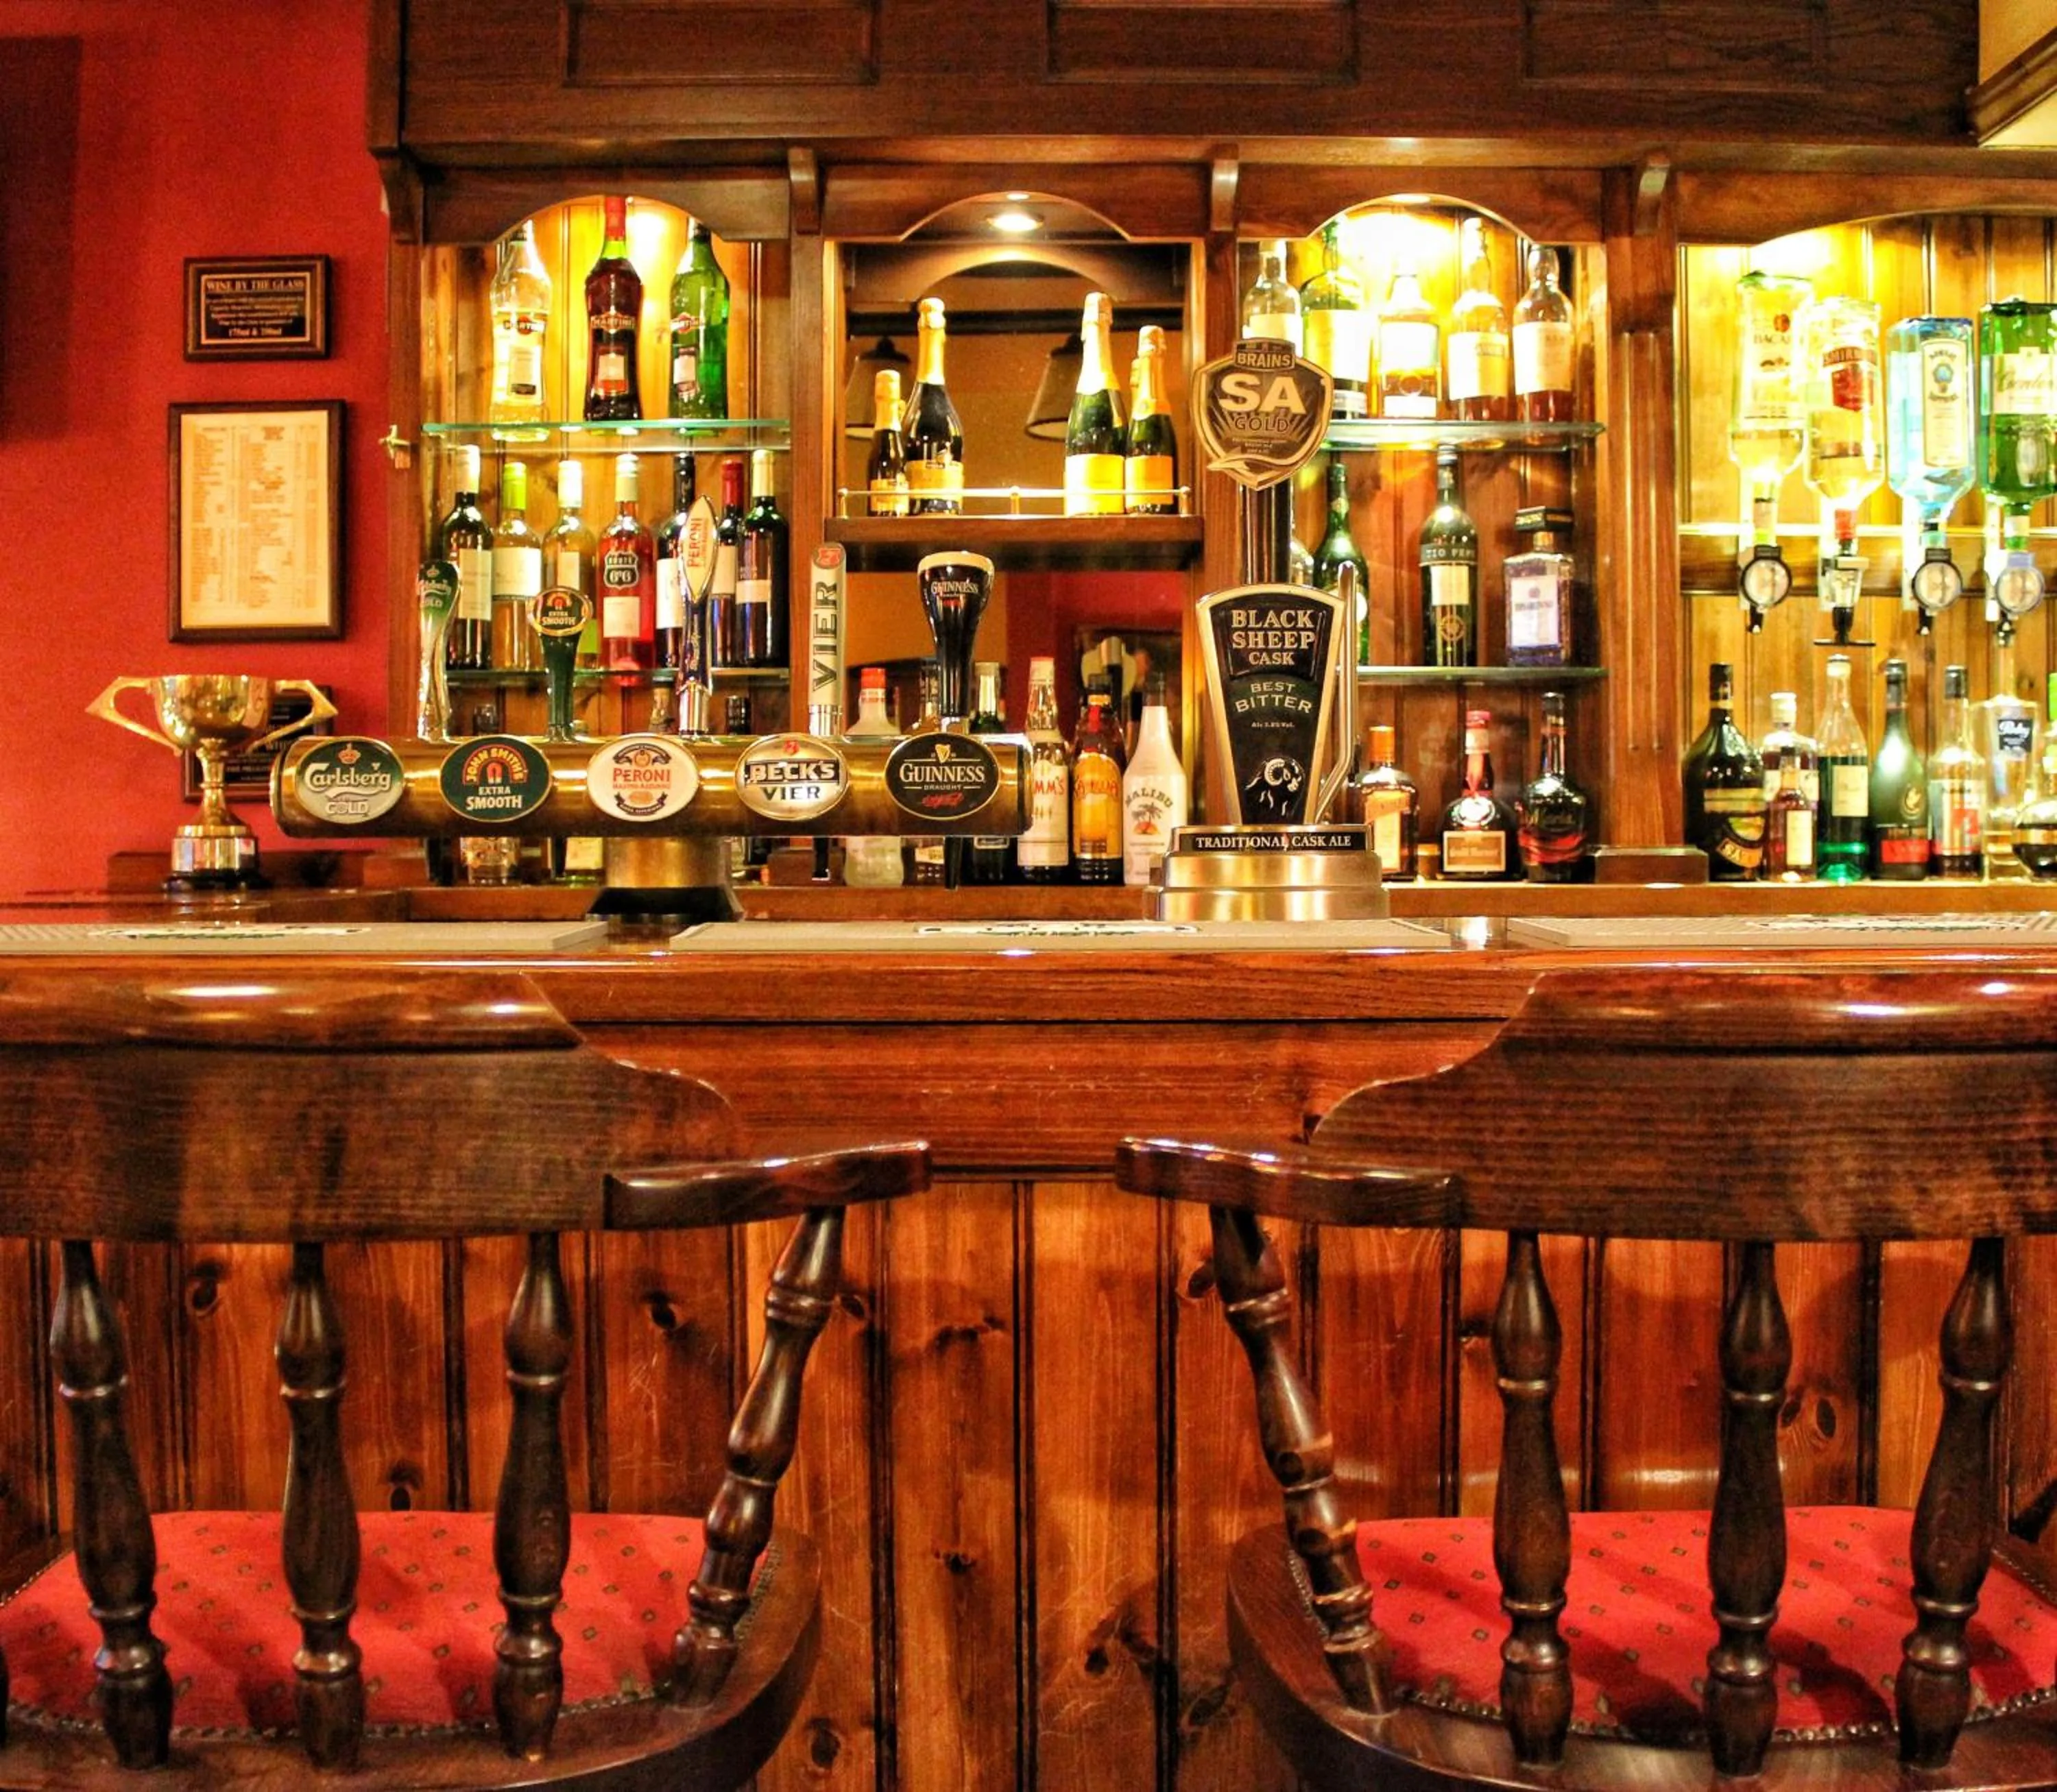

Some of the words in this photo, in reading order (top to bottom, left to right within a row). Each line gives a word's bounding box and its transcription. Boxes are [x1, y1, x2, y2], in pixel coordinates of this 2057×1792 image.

[1238, 353, 1290, 368] BRAINS
[1218, 372, 1306, 415] SA
[1235, 415, 1288, 432] GOLD
[687, 518, 703, 568] PERONI
[931, 581, 978, 594] GUINNESS
[542, 616, 576, 626] SMOOTH
[1231, 609, 1314, 628] BLACK
[813, 581, 837, 692] VIER
[1232, 631, 1316, 649] SHEEP
[1249, 652, 1295, 665] CASK
[1250, 681, 1295, 694] BEST
[1235, 694, 1312, 714] BITTER
[466, 749, 488, 782] JOHN
[490, 748, 528, 780] SMITH'S
[900, 762, 985, 783] GUINNESS
[304, 762, 391, 792] Carlsberg
[614, 767, 671, 782] PERONI
[479, 786, 511, 796] EXTRA
[760, 784, 821, 801] VIER
[1125, 787, 1173, 808] MALIBU
[466, 795, 522, 811] SMOOTH
[1196, 836, 1288, 849] TRADITIONAL
[1291, 835, 1326, 847] CASK
[1328, 835, 1351, 847] ALE
